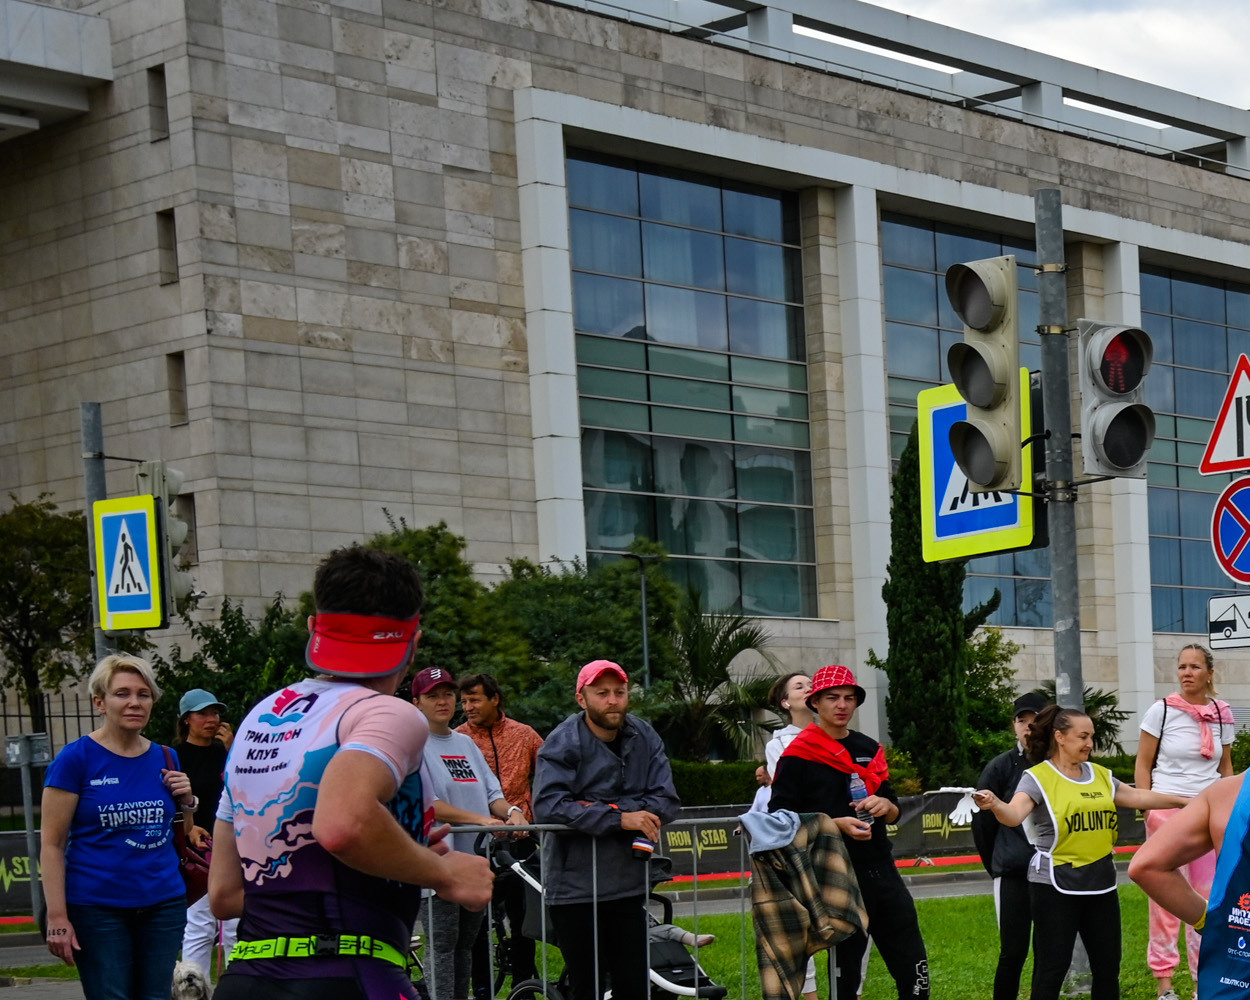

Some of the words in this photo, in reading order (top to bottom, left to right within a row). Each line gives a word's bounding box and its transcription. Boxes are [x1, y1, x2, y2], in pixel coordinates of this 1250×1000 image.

[373, 631, 404, 640] 2XU
[244, 728, 302, 743] ТРИАТЛОН
[246, 747, 279, 761] КЛУБ
[442, 759, 470, 769] MNC
[448, 769, 477, 779] HRM
[98, 804, 115, 813] 1/4
[117, 800, 164, 810] ZAVIDOVO
[923, 813, 942, 828] IRON
[666, 831, 692, 847] IRON
[701, 829, 728, 845] STAR
